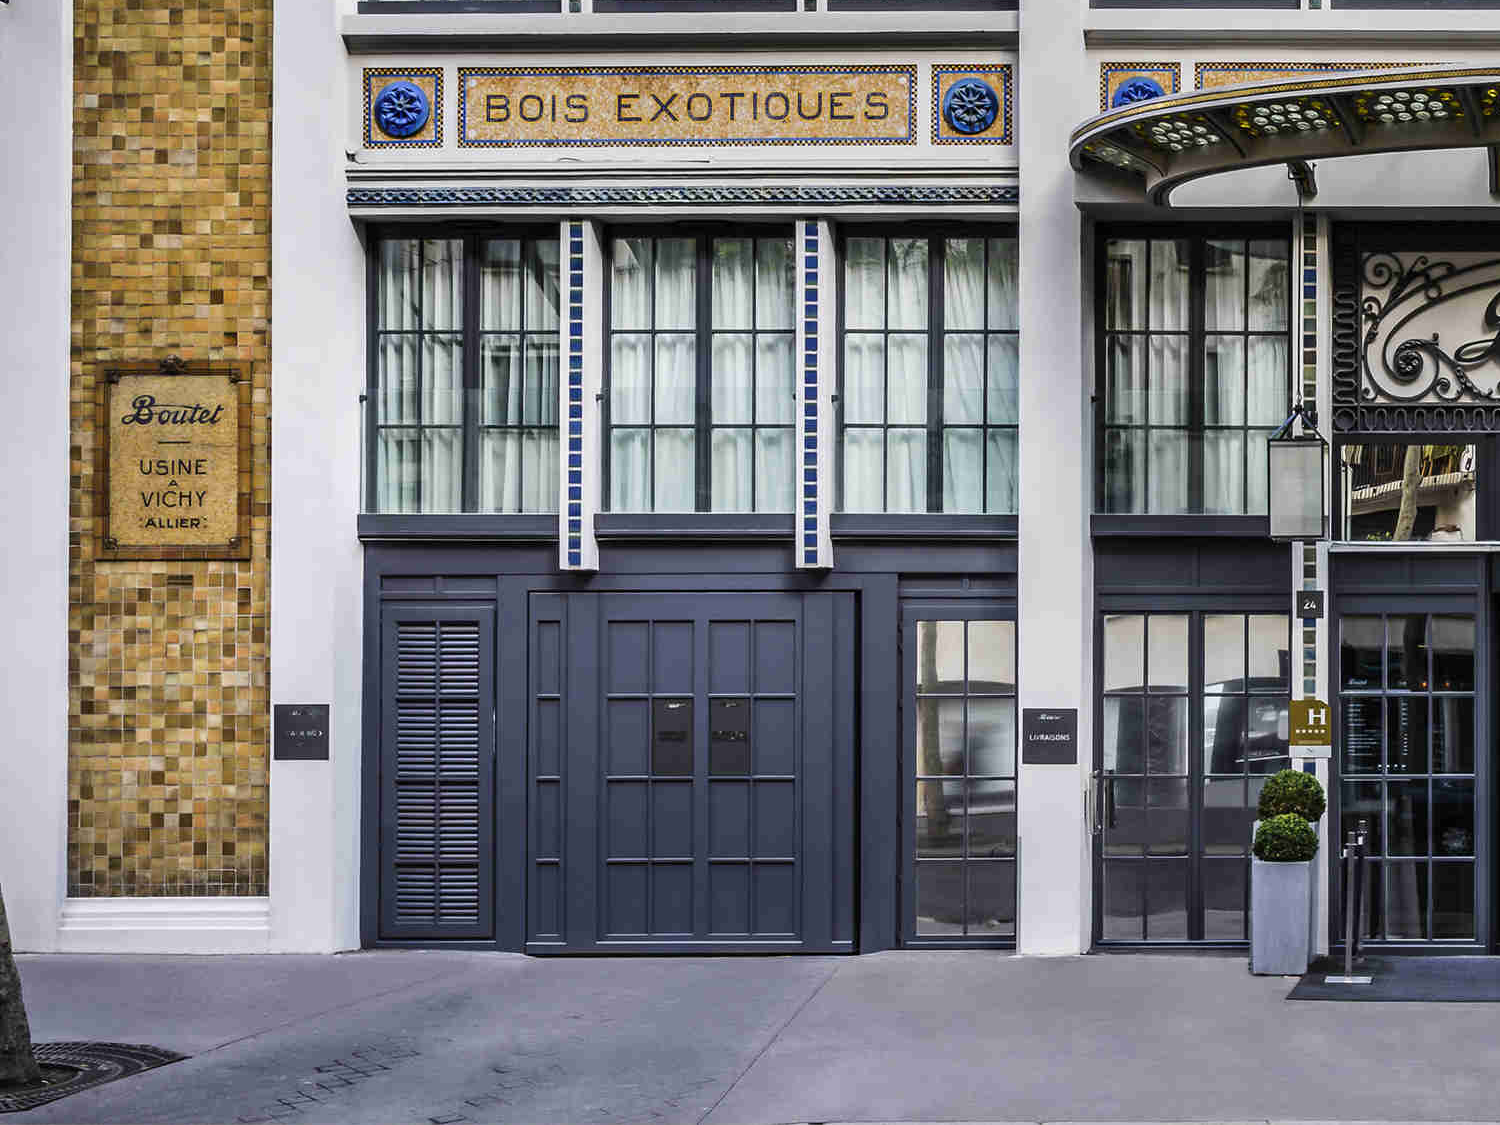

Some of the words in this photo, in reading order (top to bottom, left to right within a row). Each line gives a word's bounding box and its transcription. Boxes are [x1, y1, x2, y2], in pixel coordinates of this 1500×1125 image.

[485, 93, 590, 123] BOIS
[615, 91, 890, 123] EXOTIQUES
[121, 394, 225, 425] Boutet
[139, 459, 208, 476] USINE
[141, 490, 207, 508] VICHY
[1308, 708, 1326, 725] H
